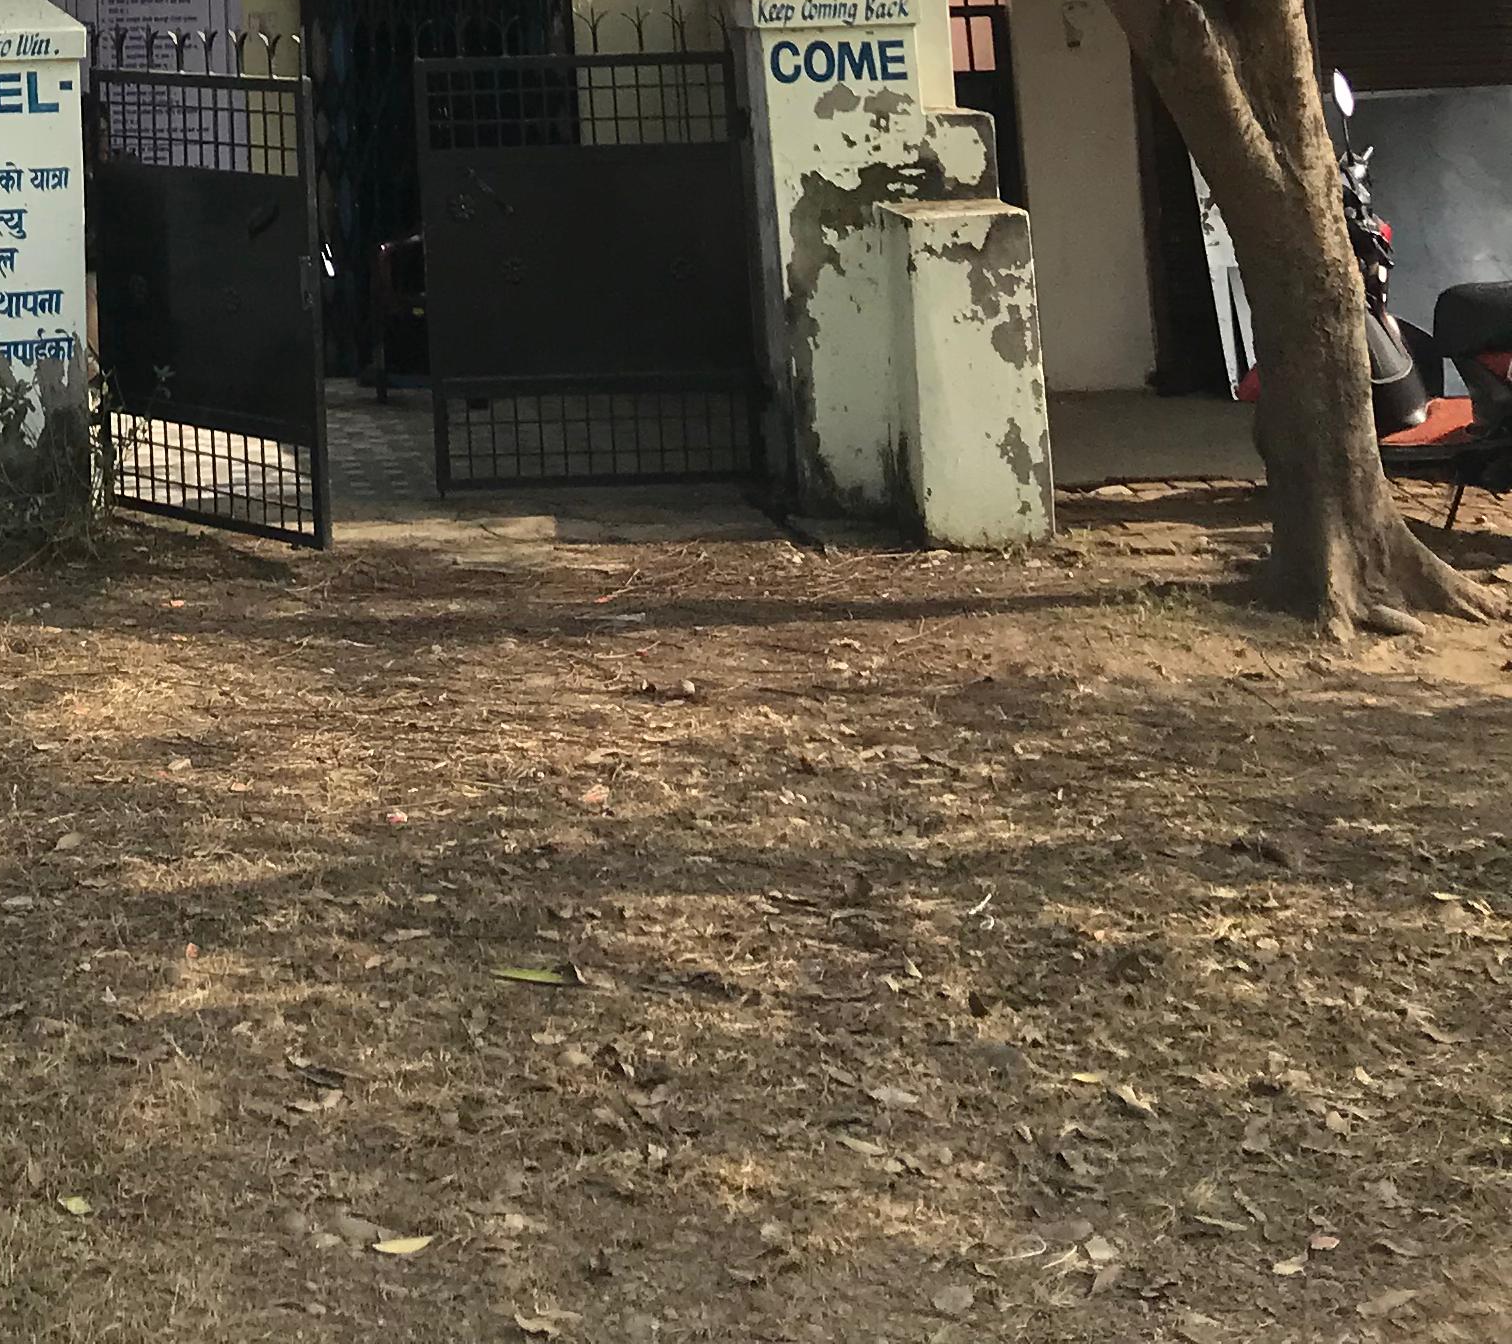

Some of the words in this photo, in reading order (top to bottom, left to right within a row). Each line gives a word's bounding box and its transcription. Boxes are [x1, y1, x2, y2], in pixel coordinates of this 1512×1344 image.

[758, 0, 796, 25] Keep
[770, 39, 908, 84] COME
[28, 167, 71, 190] यात्रा
